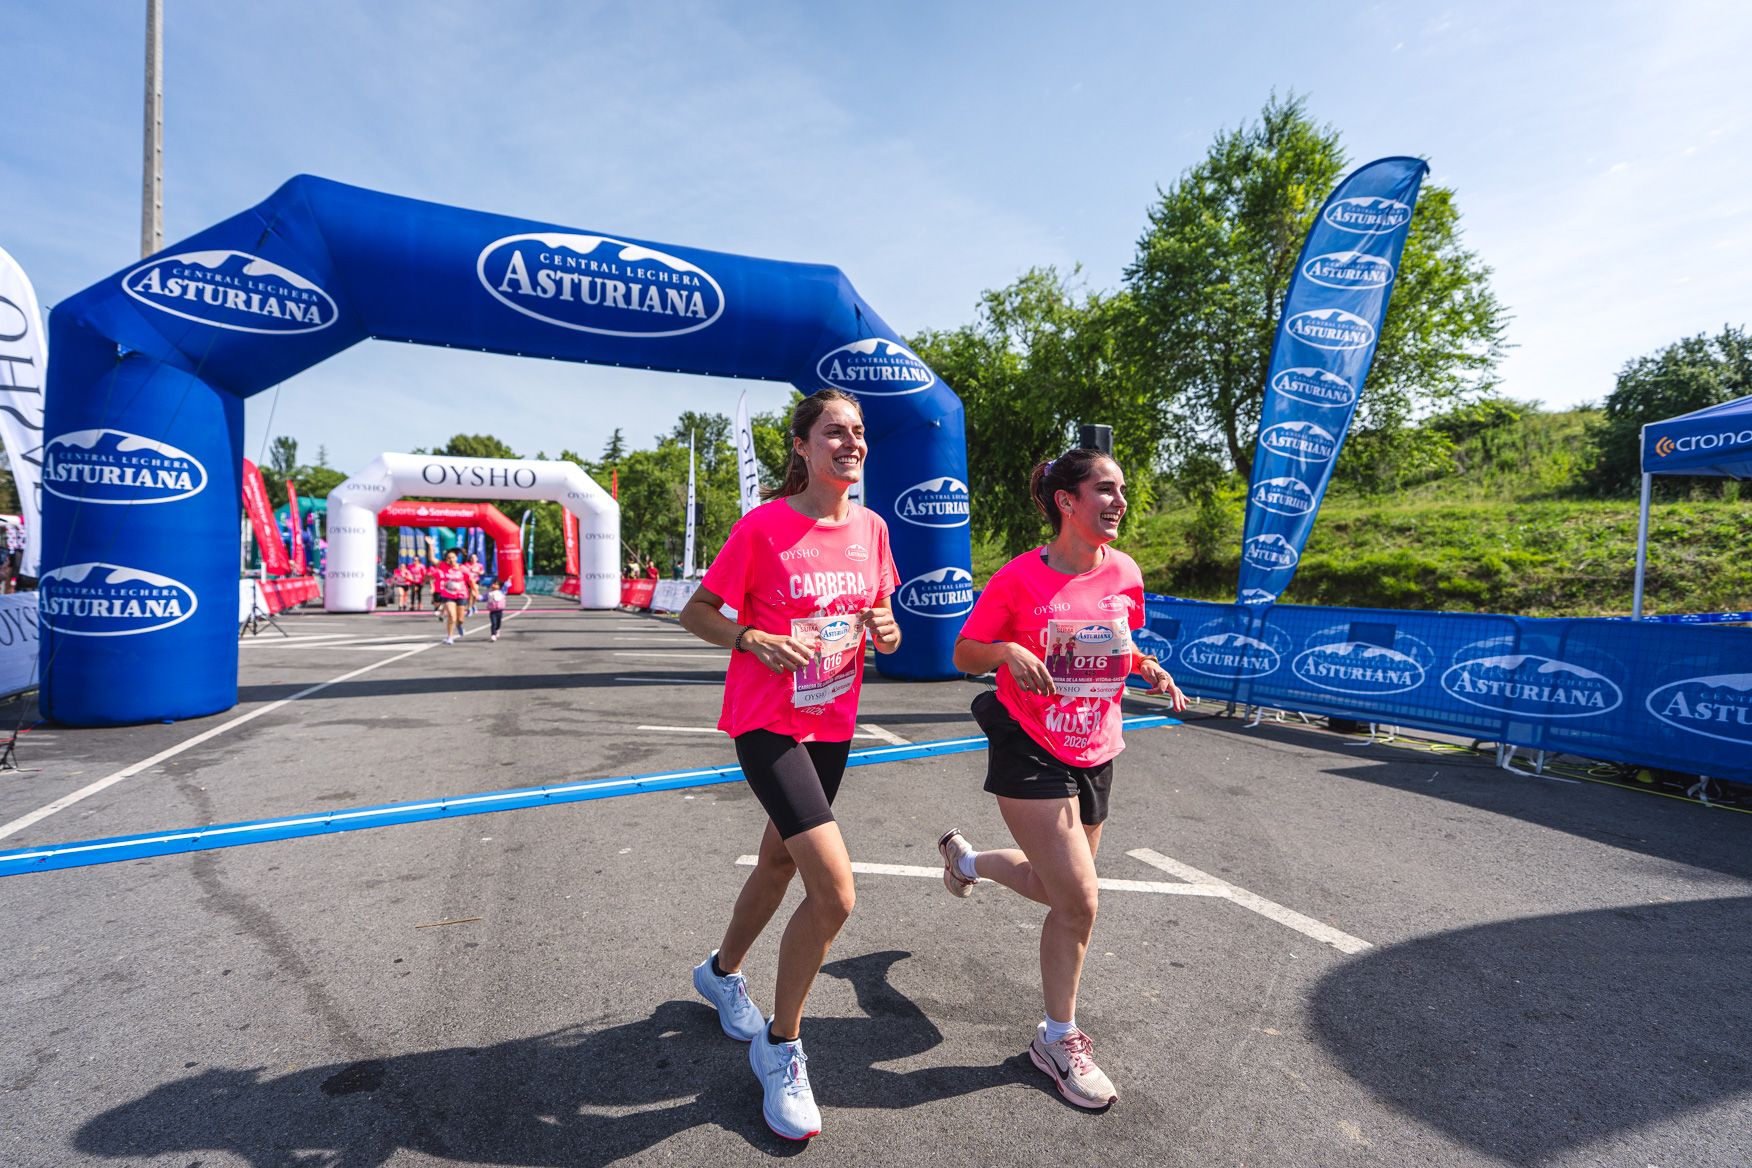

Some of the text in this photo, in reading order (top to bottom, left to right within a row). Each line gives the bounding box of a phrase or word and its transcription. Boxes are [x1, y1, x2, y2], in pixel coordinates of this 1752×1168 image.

[539, 252, 701, 287] CENTRAL LECHERA
[1308, 261, 1387, 283] ASTURIANA
[132, 267, 322, 325] ASTURIANA
[172, 267, 318, 303] CENTRAL LECHERA
[498, 249, 707, 320] ASTURIANA
[1292, 319, 1367, 344] ASTURIANA
[827, 358, 930, 382] ASTURIANA
[1278, 375, 1348, 402] ASTURIANA
[43, 452, 194, 490] ASTURIANA
[58, 451, 189, 469] CENTRAL LECHERA
[347, 483, 387, 493] OYSHO
[422, 463, 537, 489] OYSHO
[428, 507, 475, 517] Santander
[903, 496, 970, 516] ASTURIAN
[780, 547, 819, 561] OYSHO
[39, 586, 183, 617] ASTURIANA
[51, 586, 178, 597] CENTRAL LECHERA
[906, 587, 973, 606] ASTURIAN
[1033, 602, 1071, 616] OYSHO
[823, 653, 843, 671] 016
[1073, 656, 1108, 669] 016
[1186, 647, 1271, 671] ASTURIANA
[1300, 655, 1412, 685] ASTURIANA
[1452, 670, 1606, 708] ASTURIANA
[1063, 735, 1088, 748] 2026
